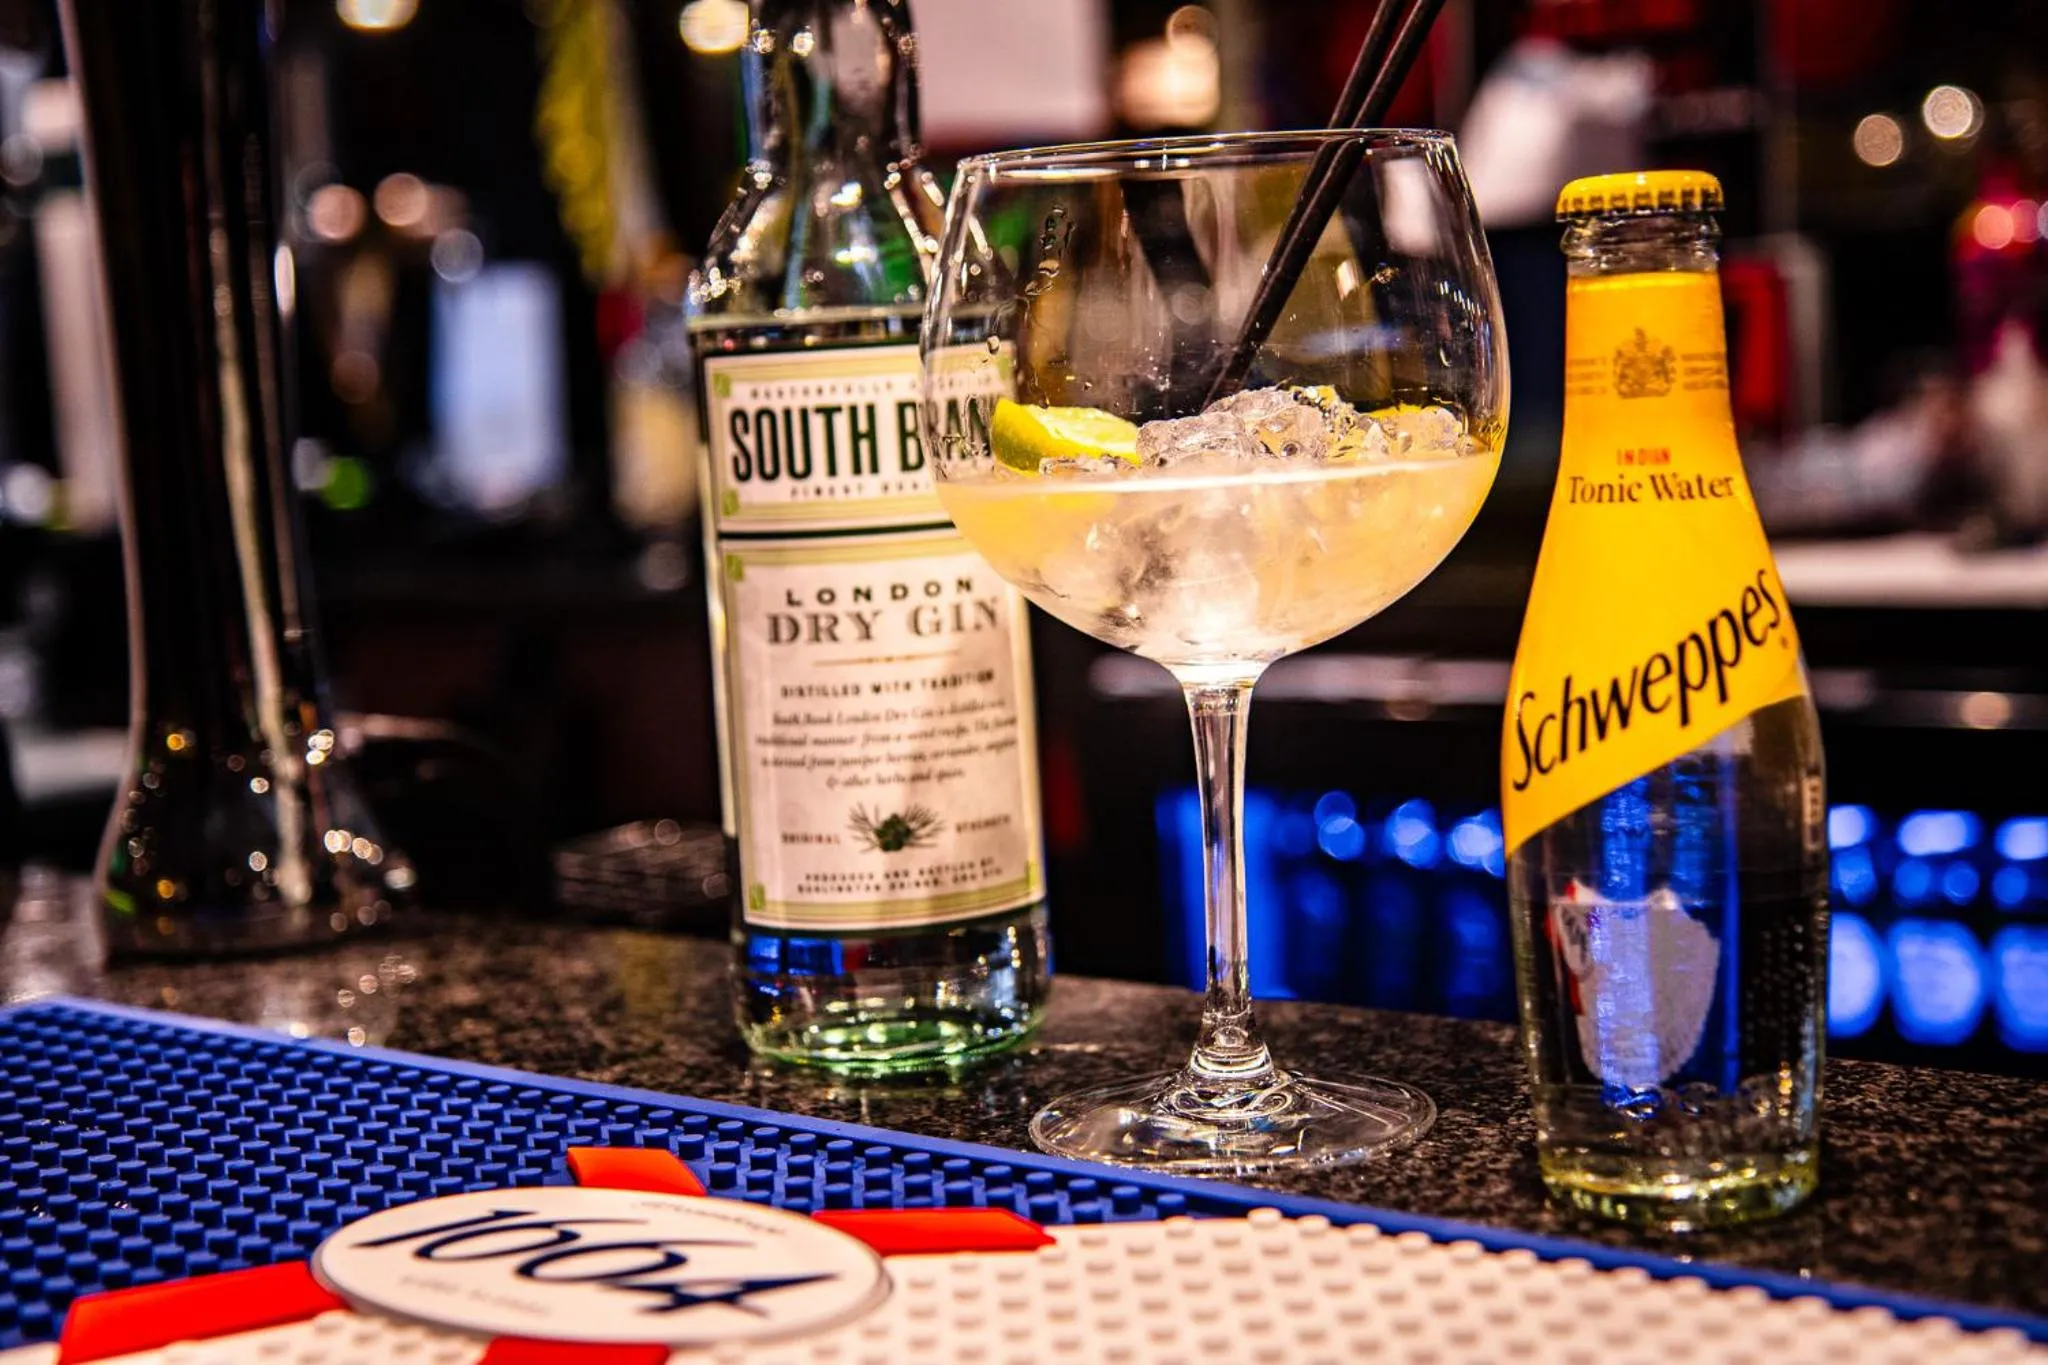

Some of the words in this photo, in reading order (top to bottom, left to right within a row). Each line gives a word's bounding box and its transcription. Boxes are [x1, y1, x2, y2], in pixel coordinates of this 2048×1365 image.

[729, 402, 880, 482] SOUTH
[1568, 473, 1643, 504] Tonic
[1648, 472, 1734, 500] Water
[785, 577, 973, 607] LONDON
[765, 609, 882, 646] DRY
[909, 596, 999, 638] GIN
[1512, 568, 1782, 792] Schweppes
